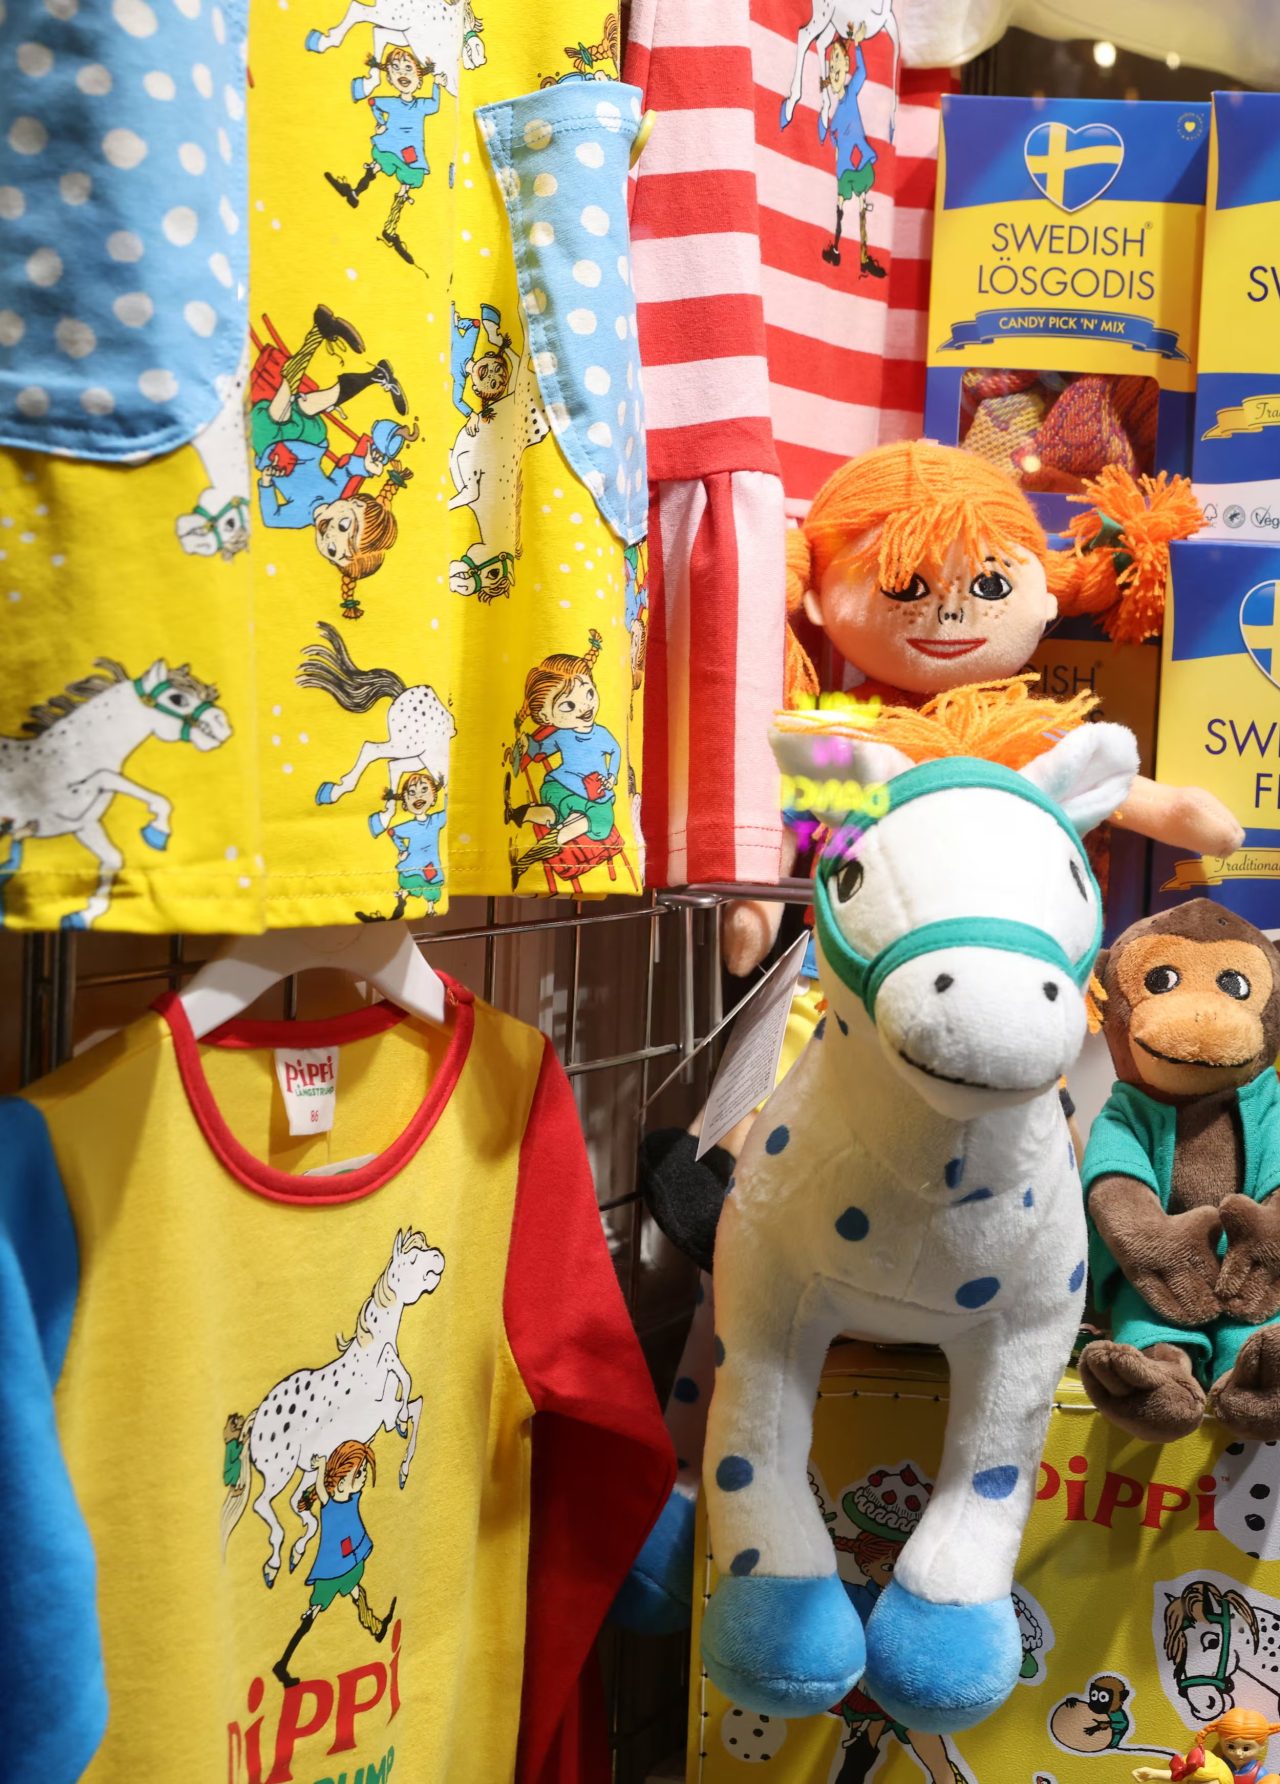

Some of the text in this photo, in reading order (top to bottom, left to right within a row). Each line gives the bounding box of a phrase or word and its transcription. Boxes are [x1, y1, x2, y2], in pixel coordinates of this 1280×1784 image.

[978, 256, 1155, 301] LÖSGODIS
[998, 316, 1046, 330] CANDY
[1048, 317, 1078, 330] PICK
[1100, 321, 1126, 334] MIX
